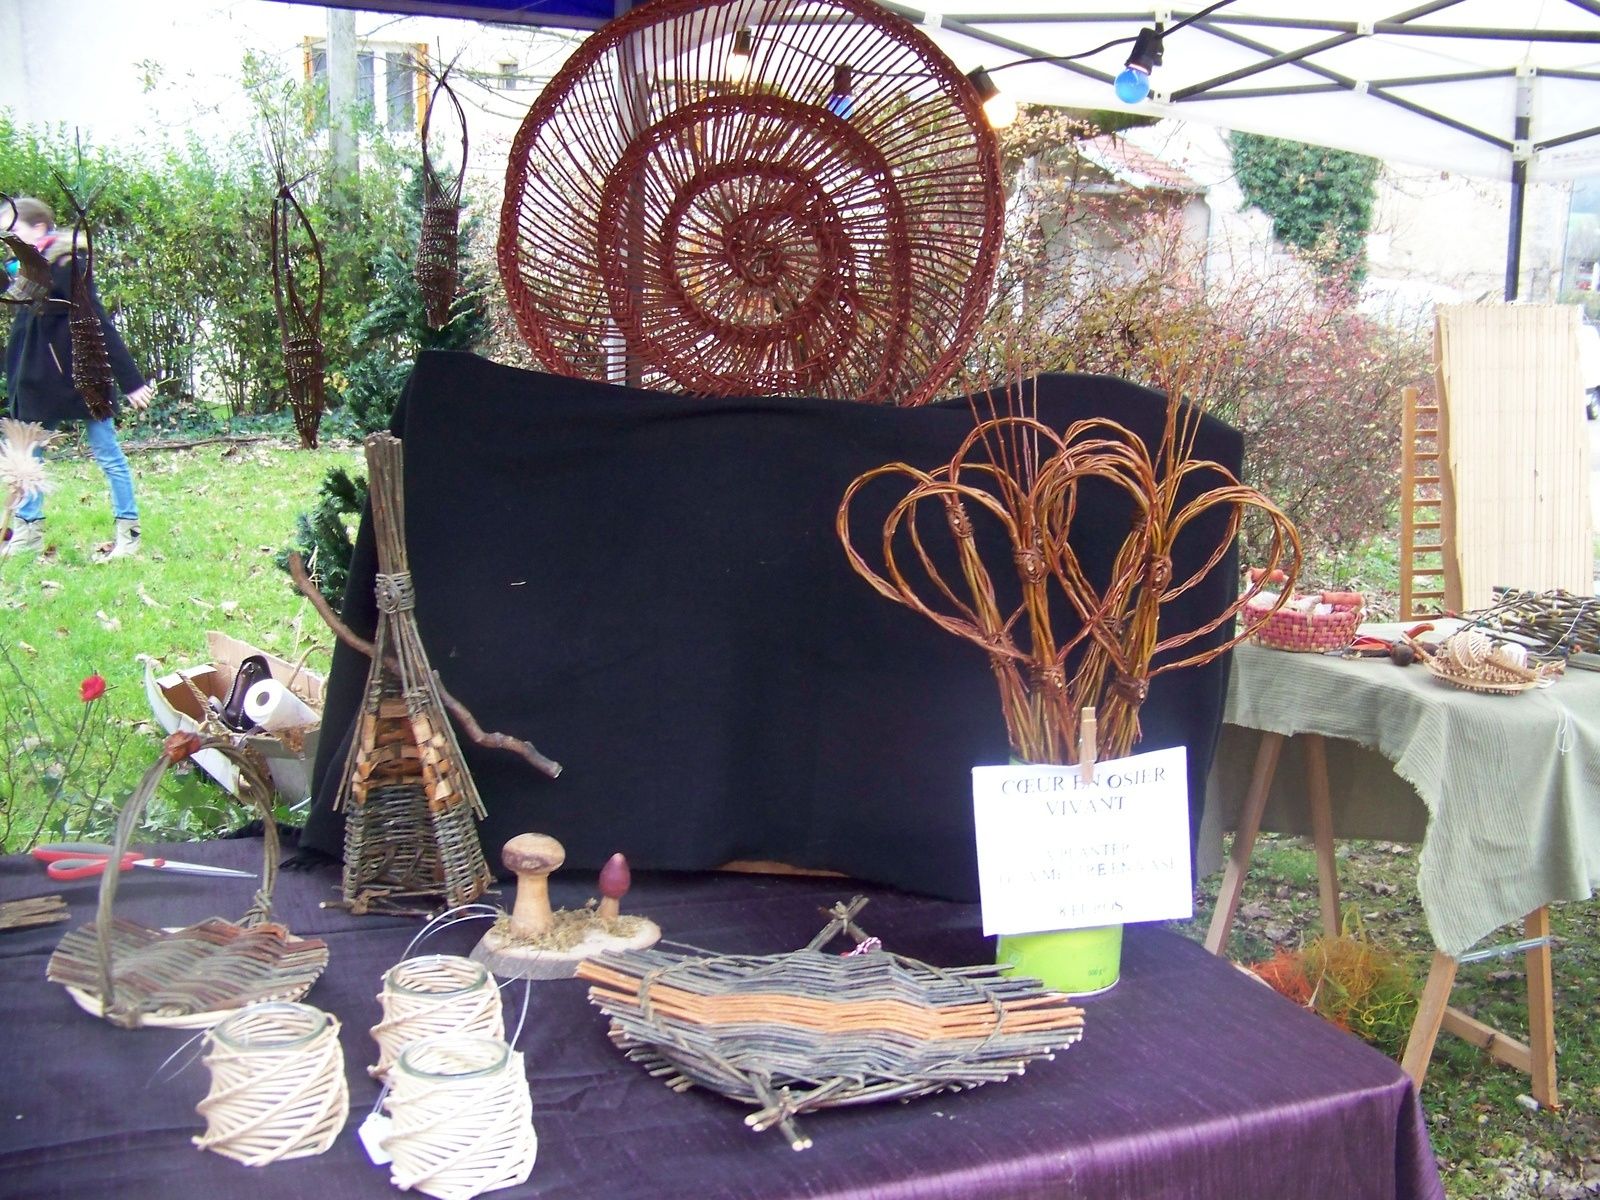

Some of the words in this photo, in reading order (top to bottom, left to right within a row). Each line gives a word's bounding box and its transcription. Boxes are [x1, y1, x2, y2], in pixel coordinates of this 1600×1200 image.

[1001, 775, 1064, 795] CŒUR
[1107, 767, 1167, 789] OSIER
[1045, 796, 1126, 816] VIVANT
